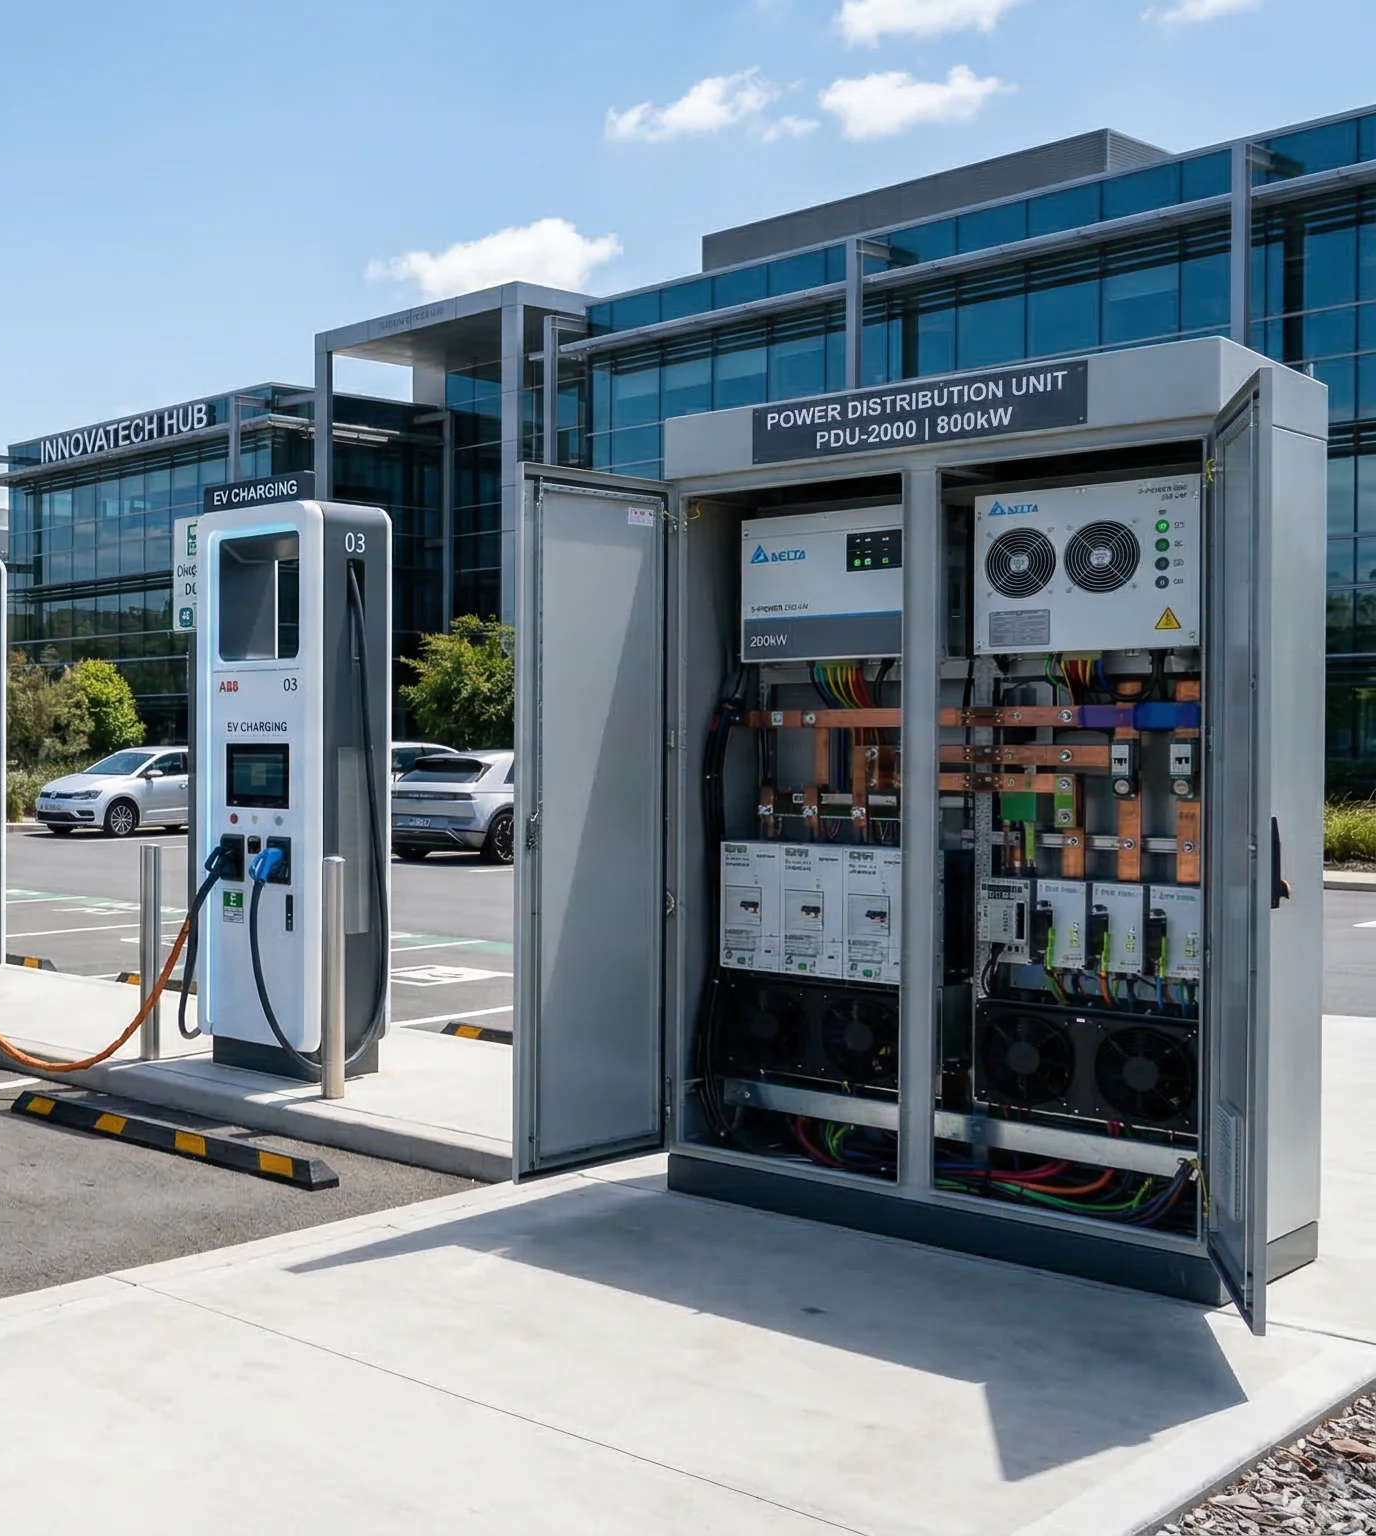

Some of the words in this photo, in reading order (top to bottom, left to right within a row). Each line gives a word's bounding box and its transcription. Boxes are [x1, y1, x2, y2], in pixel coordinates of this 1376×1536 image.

[766, 402, 842, 431] POWER
[847, 379, 1005, 419] DISTRIBUTION
[1011, 370, 1069, 396] UNIT
[39, 413, 158, 464] INNOVATECH
[163, 403, 208, 437] HUB
[815, 419, 918, 450] PDU-2000
[935, 406, 1014, 435] 800kW
[213, 489, 230, 506] EV
[231, 479, 298, 503] CHARGING
[344, 532, 366, 553] 03
[219, 680, 239, 693] ABB
[283, 677, 298, 692] 03
[240, 721, 288, 732] CHARGING
